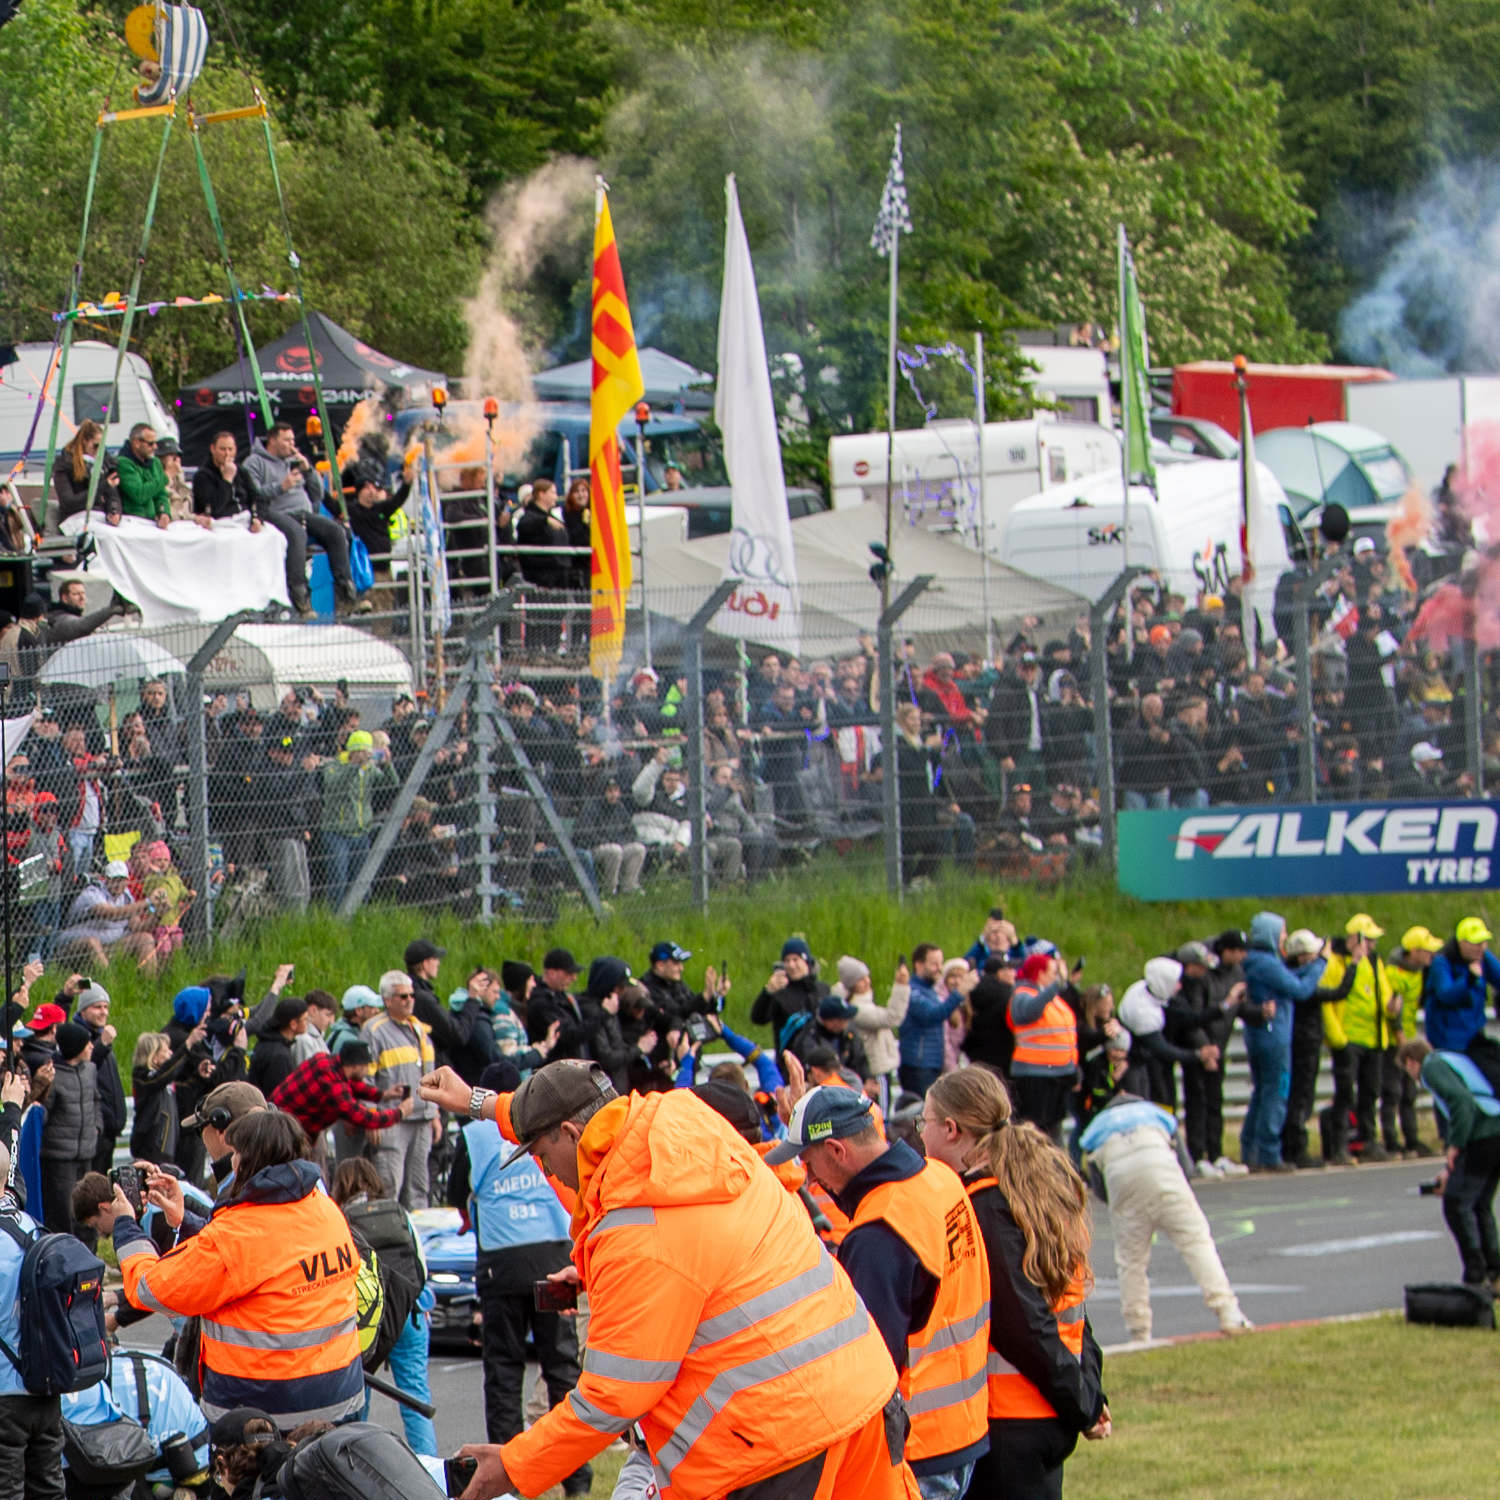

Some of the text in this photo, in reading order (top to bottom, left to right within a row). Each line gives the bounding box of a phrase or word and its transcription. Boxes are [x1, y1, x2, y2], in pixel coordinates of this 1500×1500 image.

[1174, 806, 1499, 861] FALKEN
[1406, 856, 1492, 885] TYRES
[509, 1202, 539, 1220] 831
[299, 1243, 353, 1283] VLN
